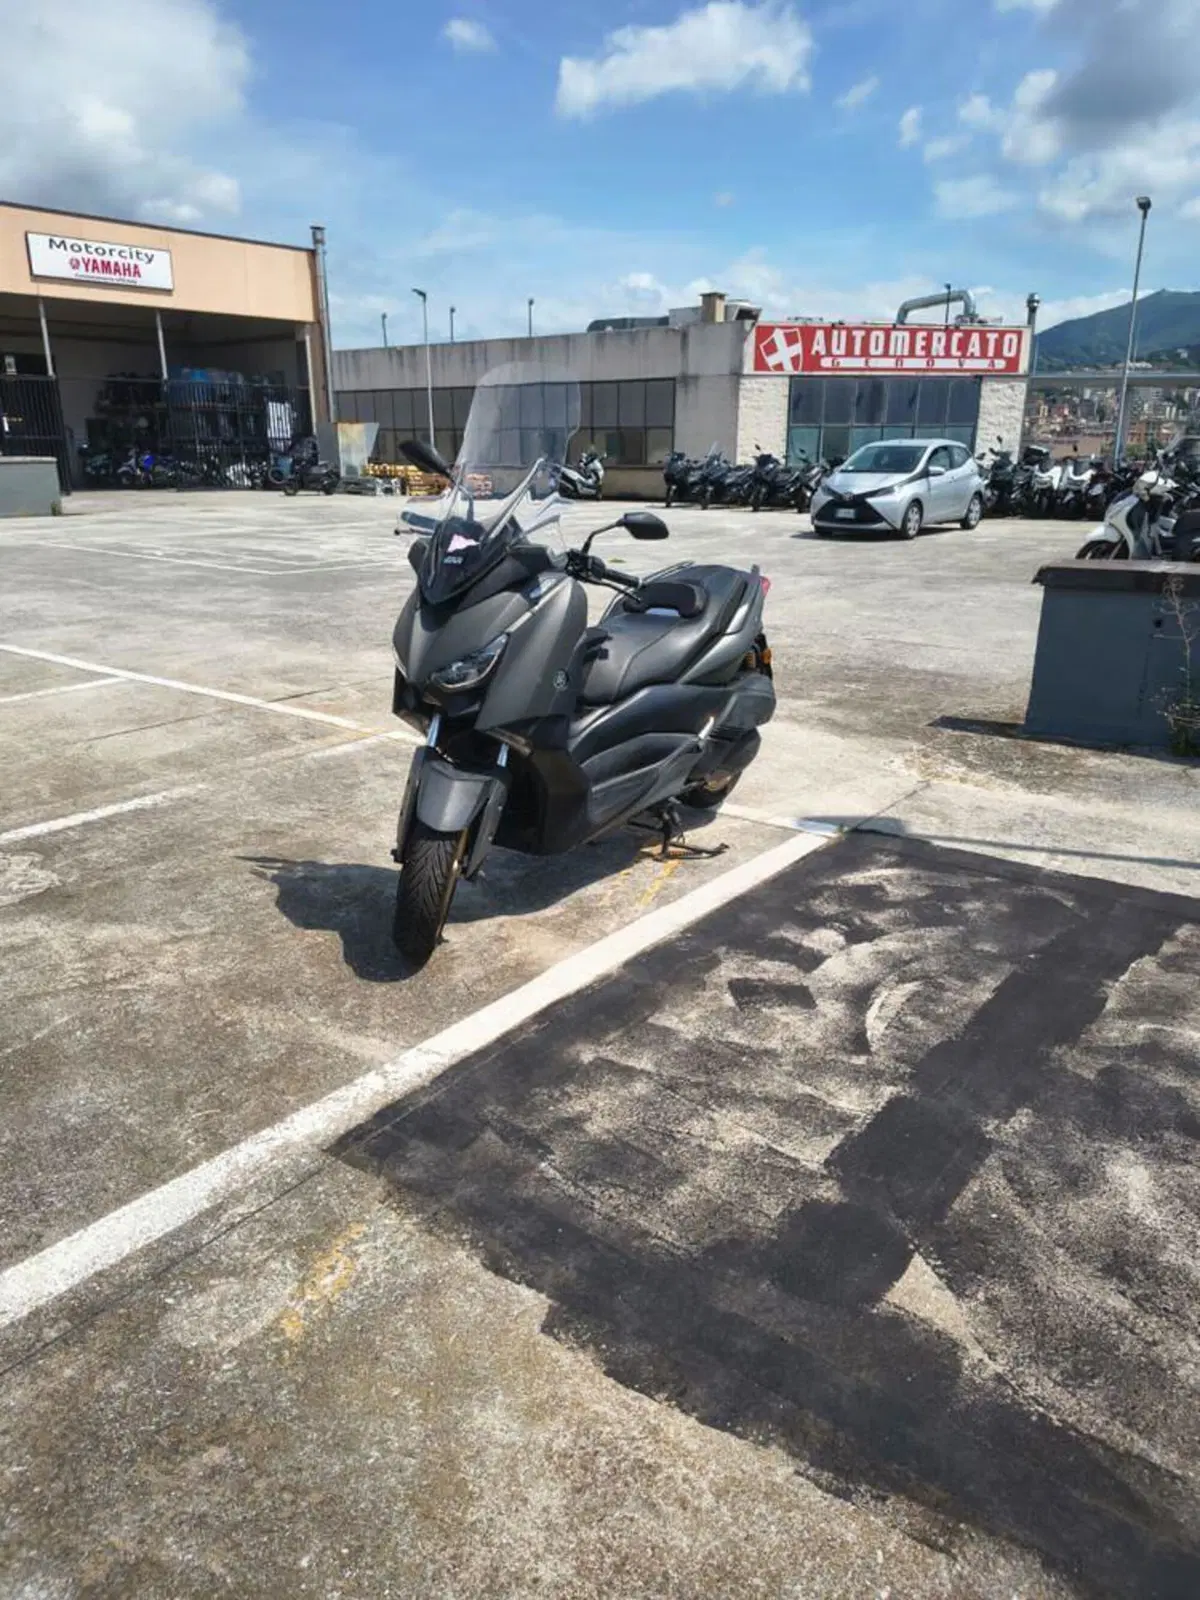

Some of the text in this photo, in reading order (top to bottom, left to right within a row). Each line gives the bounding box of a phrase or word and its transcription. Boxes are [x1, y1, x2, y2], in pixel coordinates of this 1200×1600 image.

[48, 238, 154, 264] Motorcity
[82, 257, 141, 278] YAMAHA
[811, 330, 1018, 357] AUTOMERCATO
[831, 358, 996, 368] GENOVA
